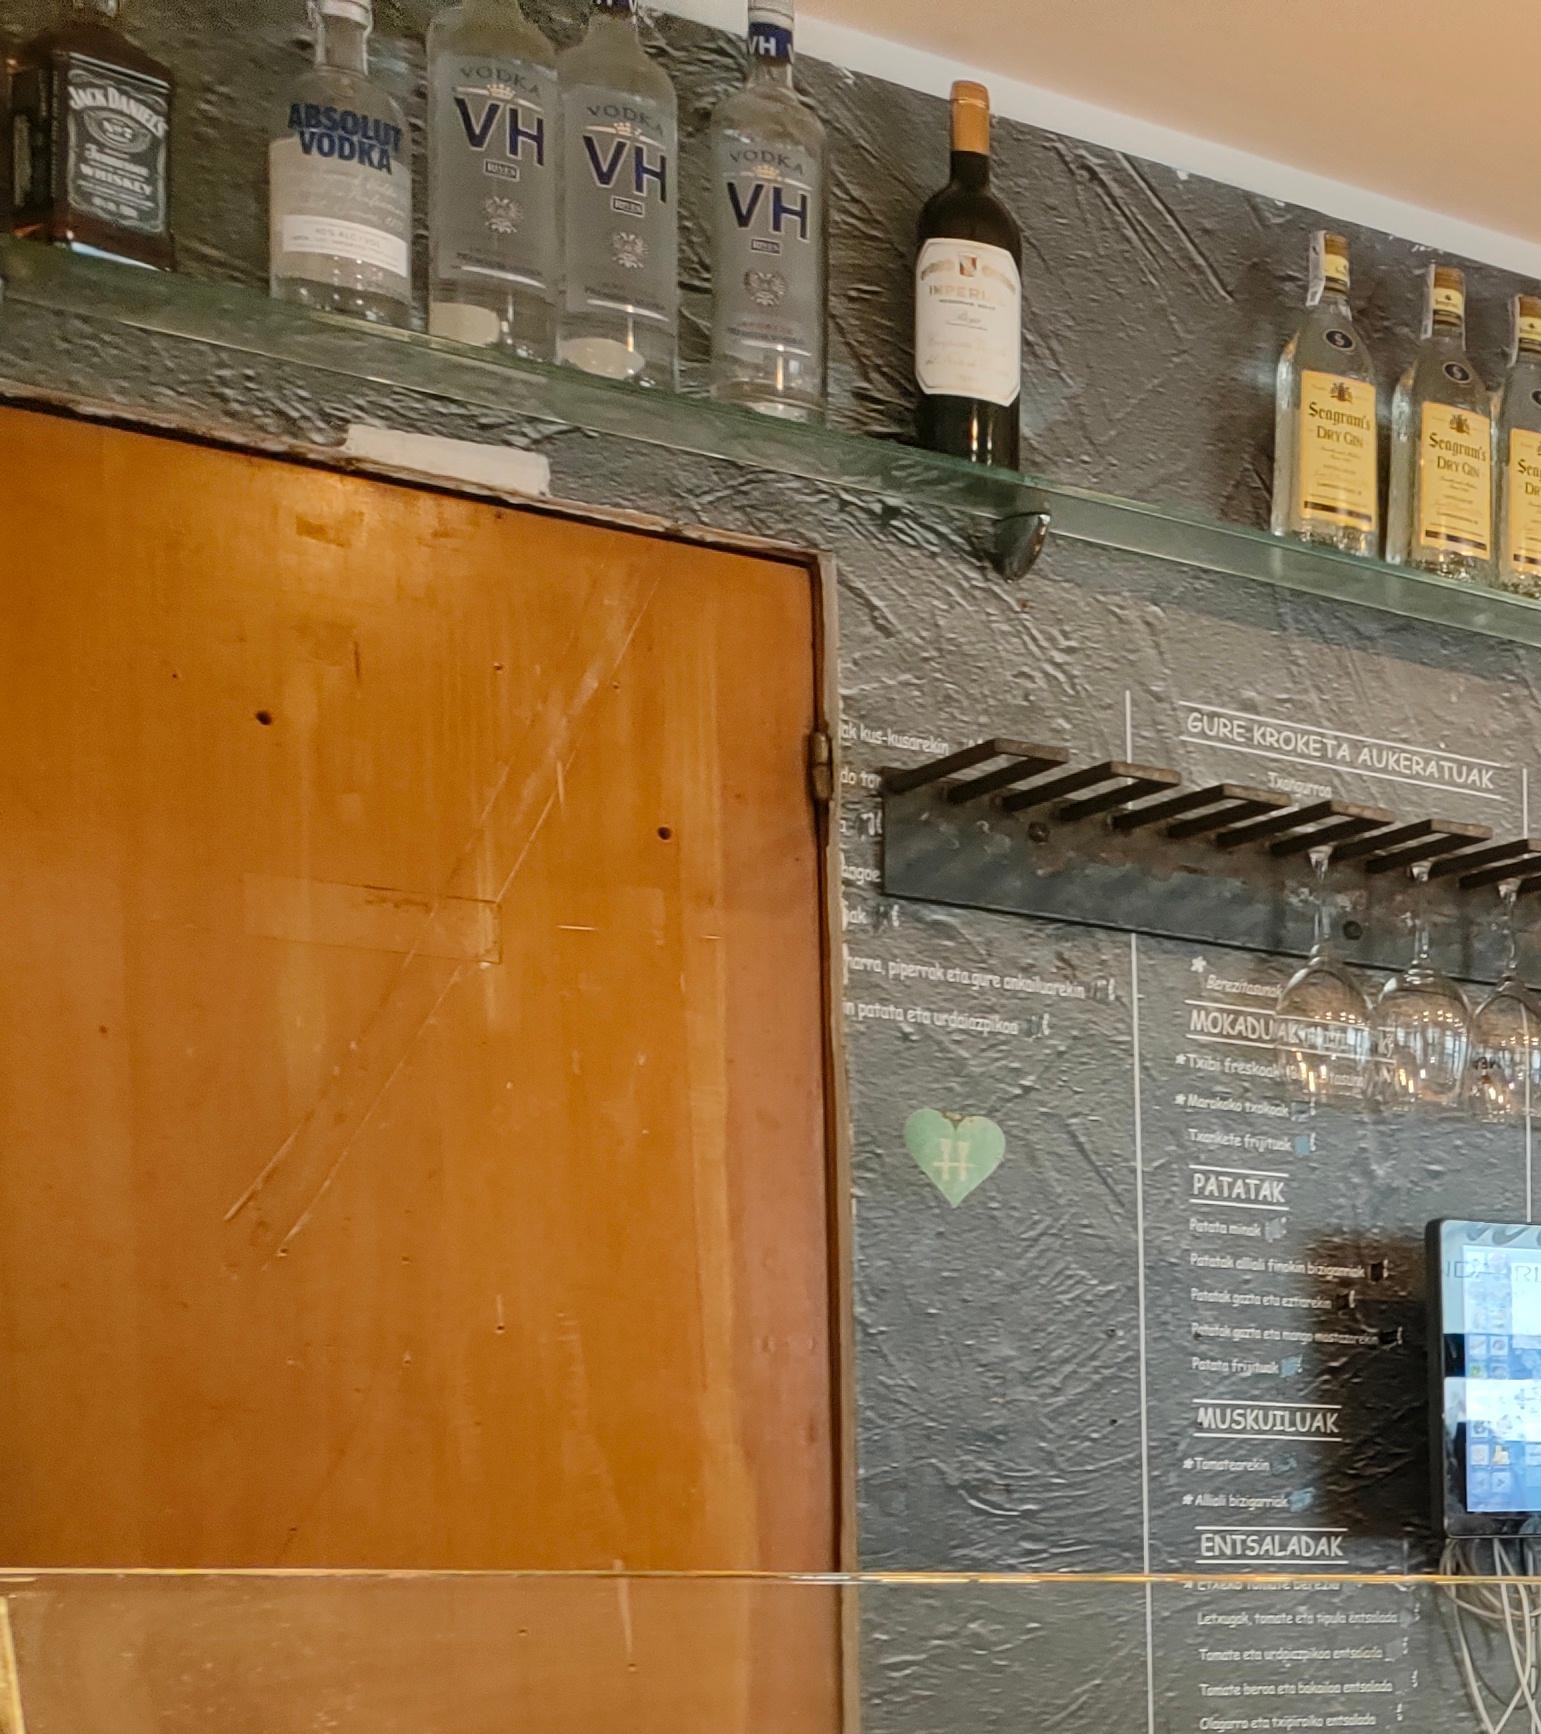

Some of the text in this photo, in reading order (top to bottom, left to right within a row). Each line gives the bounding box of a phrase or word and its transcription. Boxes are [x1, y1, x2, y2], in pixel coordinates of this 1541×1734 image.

[459, 65, 539, 94] VODKA
[288, 102, 402, 151] ABSOLUT
[454, 96, 545, 167] VH
[587, 104, 664, 138] VODKA
[299, 131, 392, 175] VODKA
[729, 150, 804, 176] VODKA
[583, 135, 667, 203] VH
[727, 181, 811, 241] VH
[1309, 402, 1370, 431] Seagram's
[1317, 425, 1363, 448] DRY GIN
[1429, 431, 1486, 462] Seagram's
[1437, 456, 1480, 478] DRY GIN
[1187, 712, 1494, 790] GURE KROKETA AUKERATUAK
[1193, 1173, 1284, 1203] PATATAK
[1197, 1407, 1339, 1433] MUSKUILUAK
[1201, 1534, 1343, 1557] ENTSALADAK
